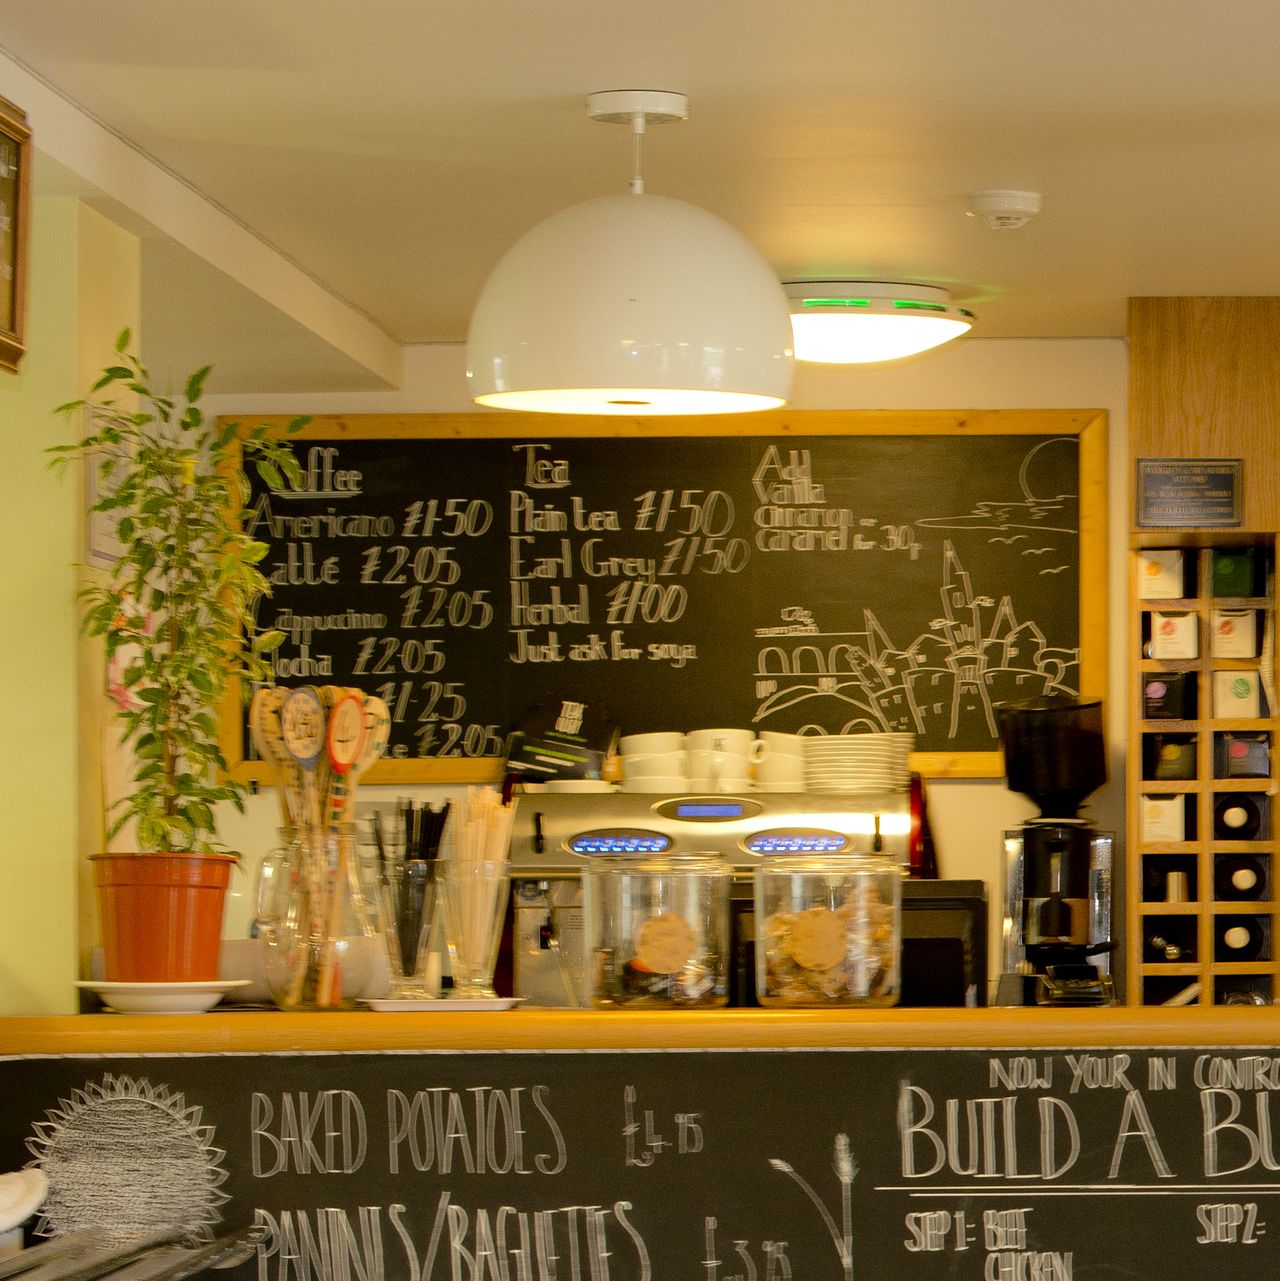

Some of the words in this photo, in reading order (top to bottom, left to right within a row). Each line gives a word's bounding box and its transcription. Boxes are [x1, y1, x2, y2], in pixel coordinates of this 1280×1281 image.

[512, 444, 571, 485] Tea
[752, 445, 812, 480] Add
[509, 490, 567, 532] Plain
[570, 497, 621, 531] tea
[509, 536, 572, 579] Earl
[581, 538, 655, 585] Grey
[510, 580, 589, 625] Herbal
[508, 629, 565, 663] Just
[569, 634, 608, 661] ask
[611, 630, 643, 660] for
[648, 644, 698, 667] soya
[990, 1056, 1052, 1091] NOW
[1065, 1055, 1131, 1093] YOUR
[1149, 1057, 1176, 1090] IN
[251, 1089, 367, 1177] BAKED
[387, 1085, 567, 1175] POTATOES
[899, 1085, 1080, 1180] BUILD
[1108, 1089, 1177, 1178] A
[904, 1210, 951, 1251] STEP
[983, 1208, 1034, 1250] BEEF
[1197, 1203, 1243, 1244] STEP
